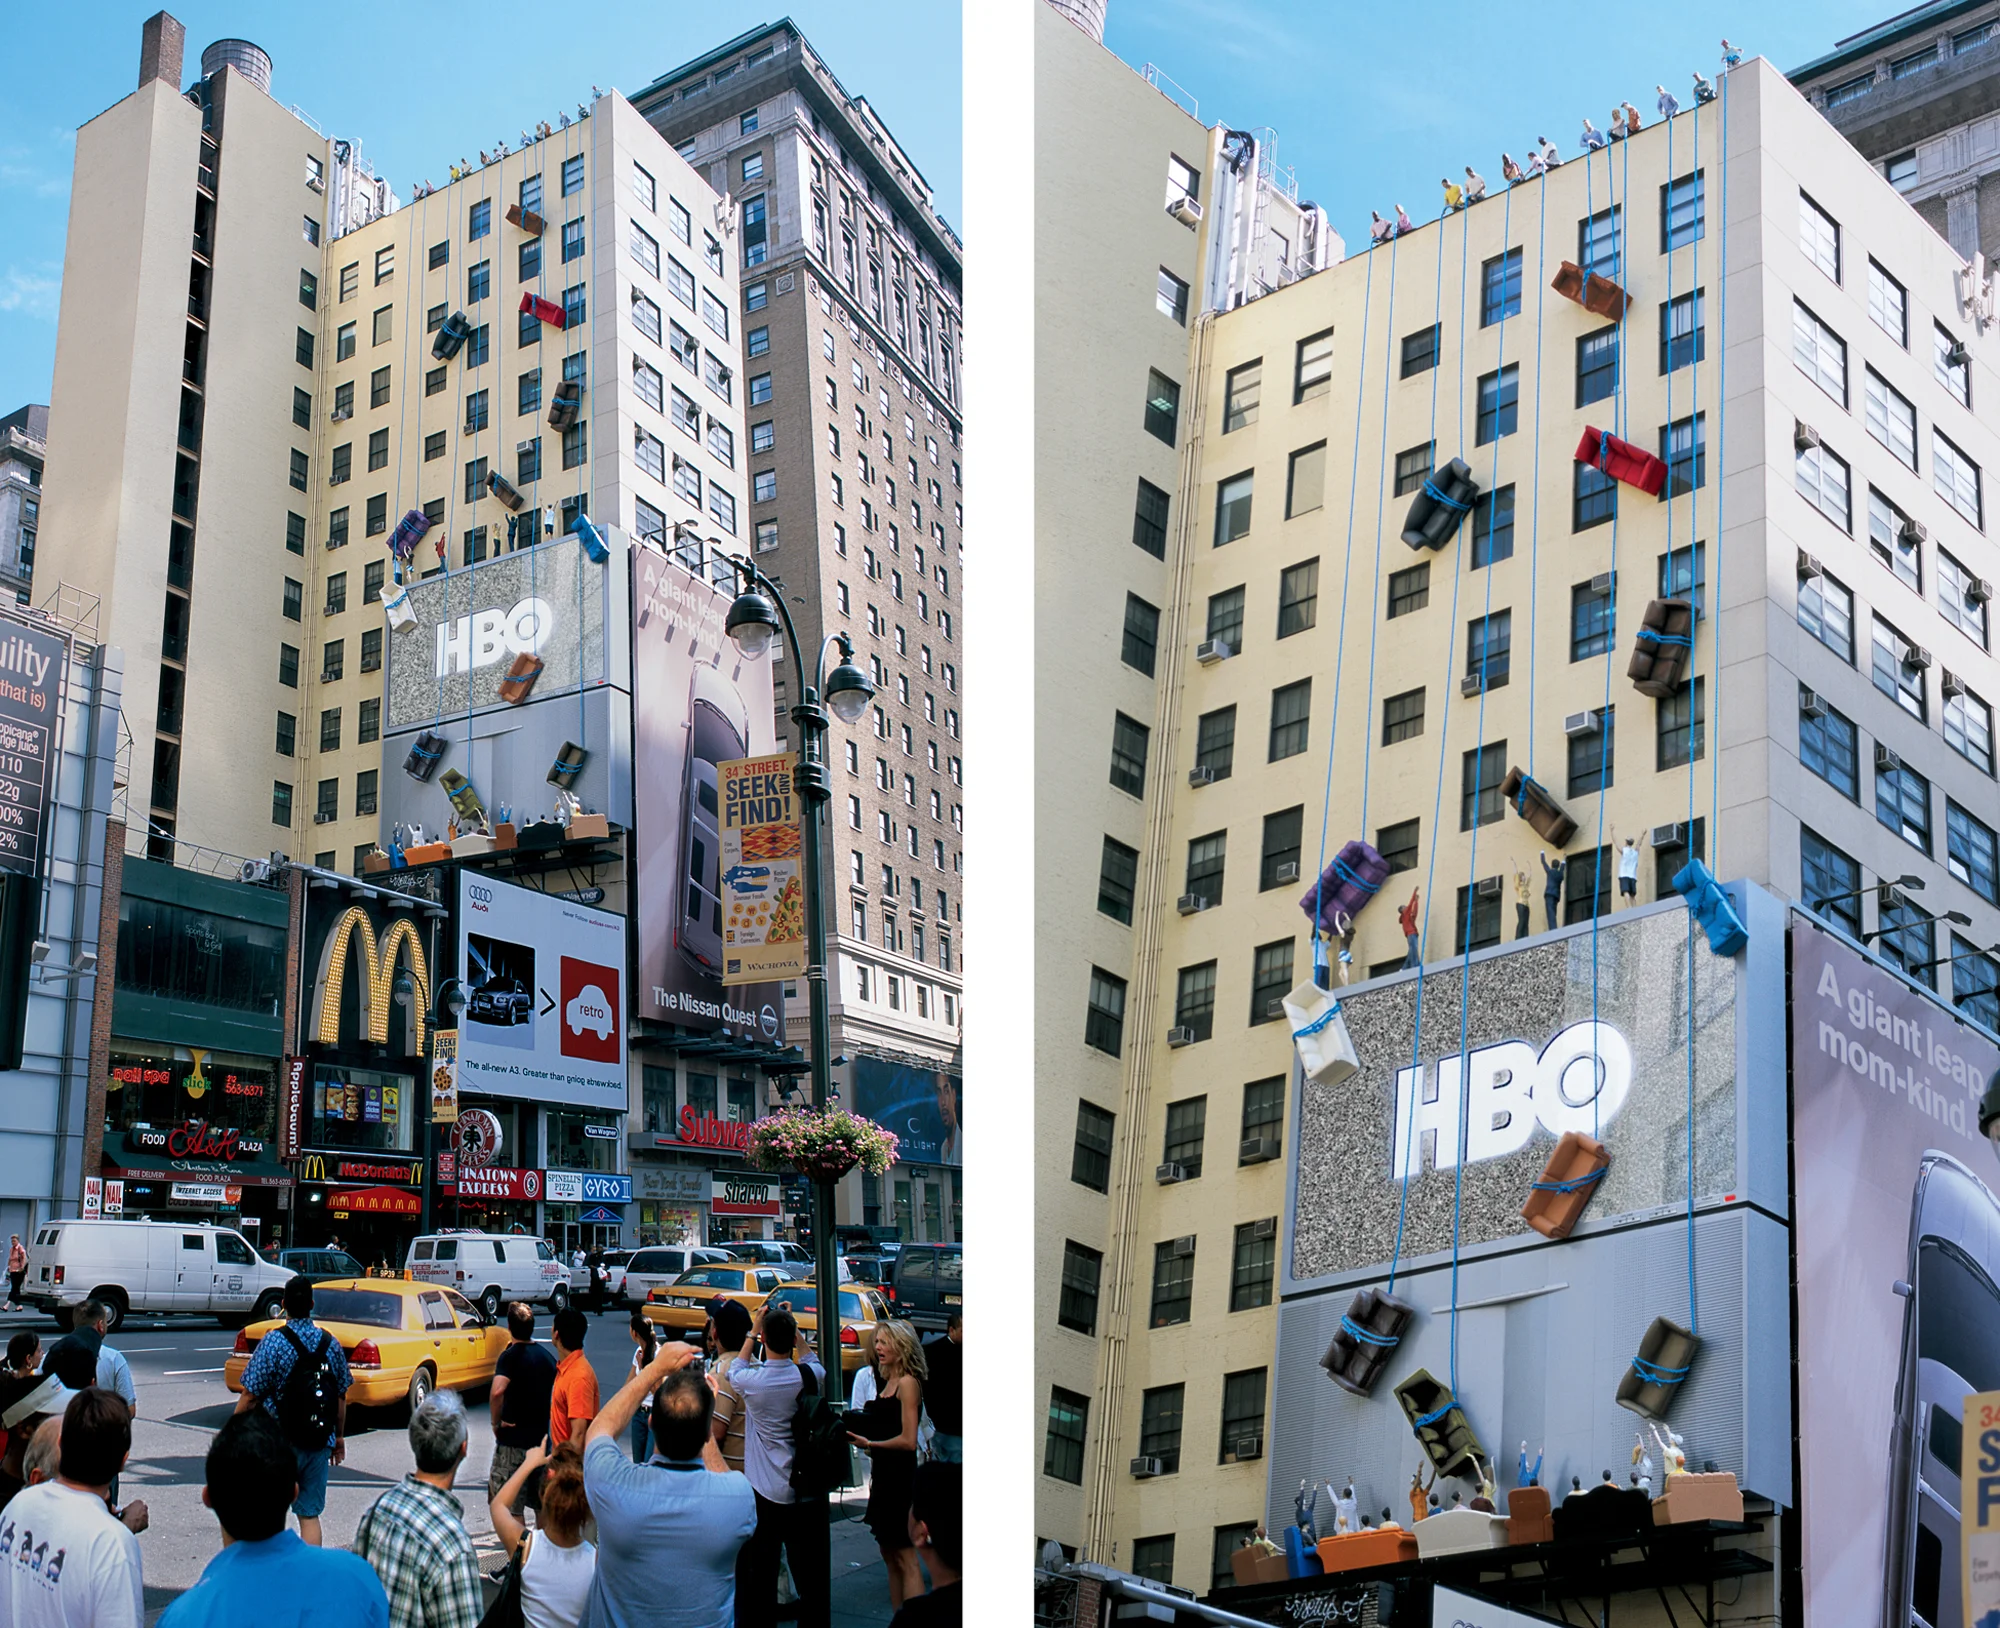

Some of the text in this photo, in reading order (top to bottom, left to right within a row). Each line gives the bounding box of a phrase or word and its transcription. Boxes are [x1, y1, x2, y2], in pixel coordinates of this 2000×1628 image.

[643, 565, 656, 587] A
[658, 577, 697, 612] giant
[435, 596, 552, 678] HBO
[17, 739, 39, 755] juice
[744, 760, 789, 776] STREET.
[726, 773, 779, 801] SEEK
[779, 773, 790, 794] AND
[726, 796, 791, 827] FIND!
[471, 901, 489, 912] Audi
[747, 961, 799, 971] WACHOVIA
[579, 1003, 604, 1019] retro
[652, 985, 757, 1027] The Nissan Quest
[1816, 962, 1985, 1100] A giant leap
[113, 1067, 170, 1084] nail spa
[465, 1060, 565, 1081] The all-new A3. Greater than
[182, 1075, 212, 1091] slick
[1819, 1020, 1973, 1141] mom-kind.
[289, 1061, 303, 1155] Applebaum's
[1391, 1018, 1633, 1180] HBO
[587, 1126, 616, 1136] Van Wagner
[679, 1104, 751, 1148] Subwa
[142, 1133, 165, 1145] FOOD
[238, 1141, 263, 1152] PLAZA
[913, 1141, 936, 1151] LIGHT
[127, 1169, 166, 1179] FREE DELIVERY
[195, 1173, 232, 1183] FOOD PLAZA
[339, 1161, 411, 1180] McDonald's
[458, 1166, 518, 1183] HINATOWN
[87, 1180, 100, 1195] NAIL
[106, 1185, 121, 1204] NAIL
[175, 1187, 201, 1195] INTERNET
[203, 1188, 222, 1196] ACCESS
[459, 1181, 510, 1196] EXPRESS
[554, 1183, 575, 1192] PIZZA
[585, 1178, 620, 1198] GYRO
[724, 1176, 769, 1205] sbarro
